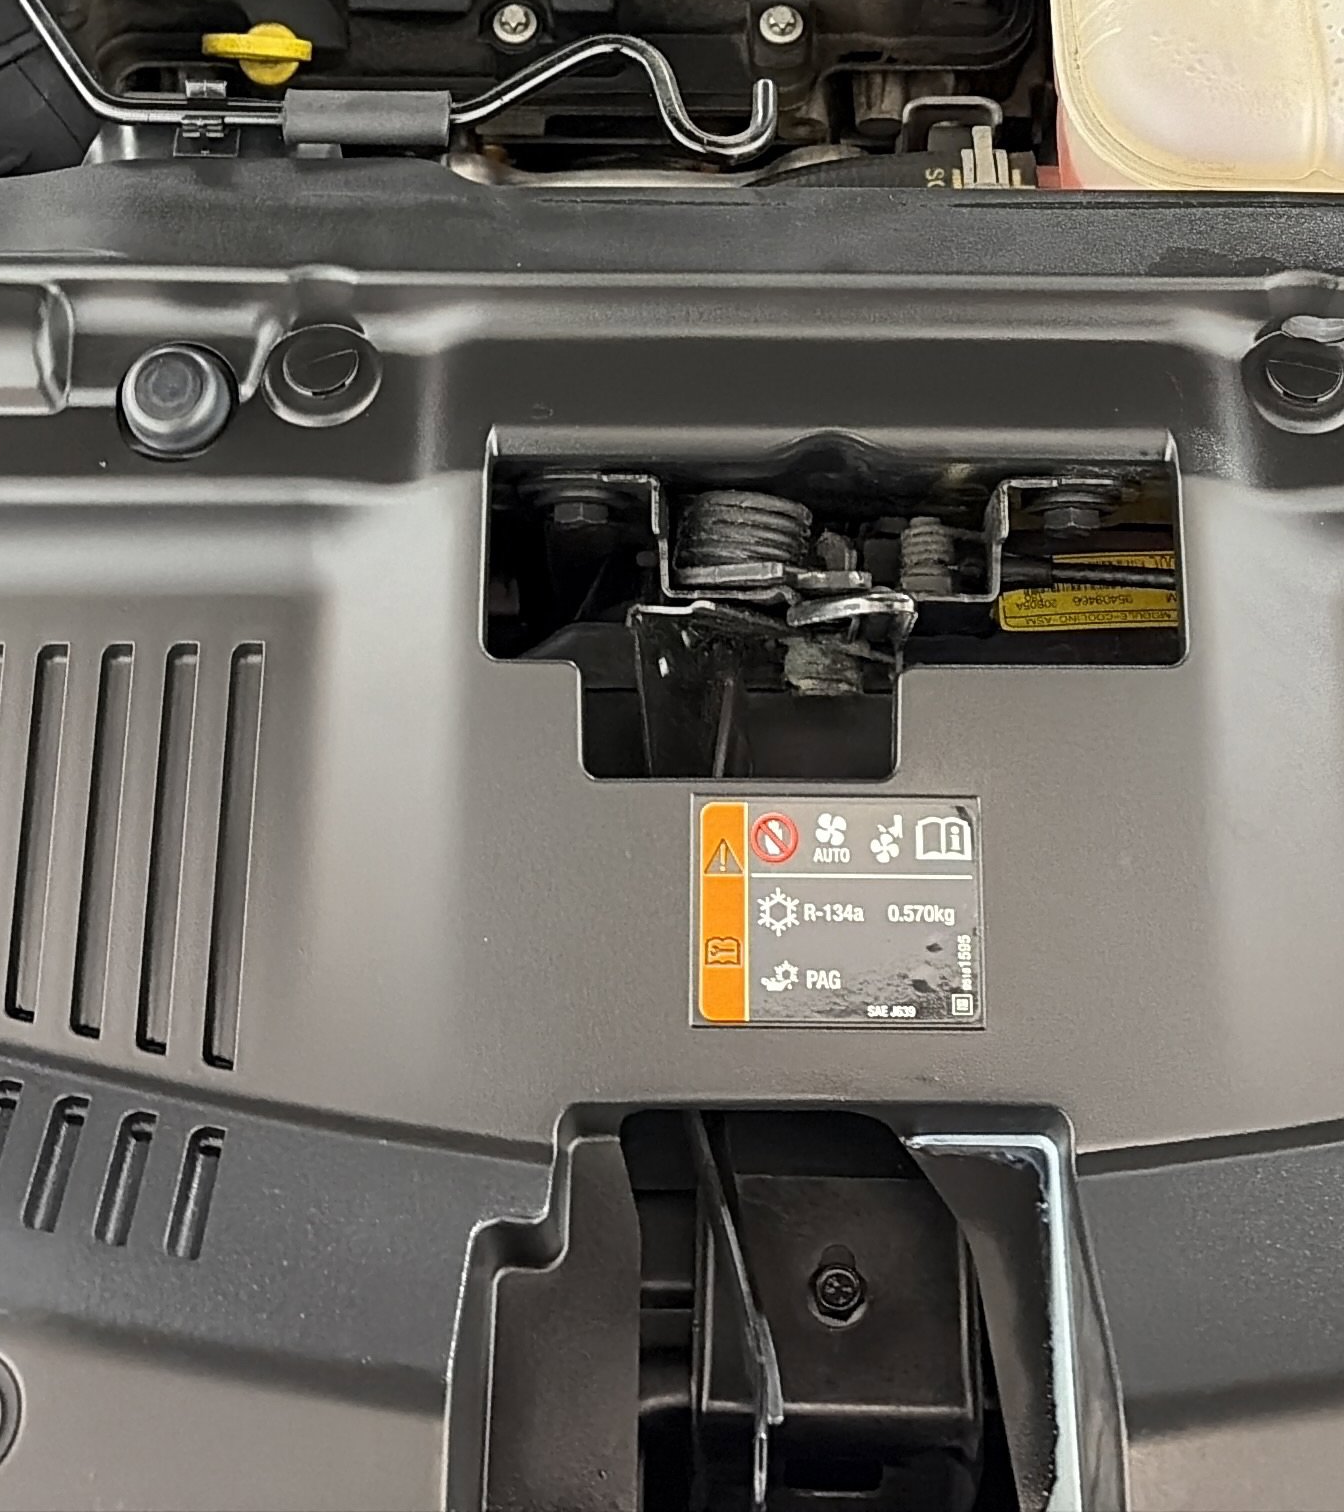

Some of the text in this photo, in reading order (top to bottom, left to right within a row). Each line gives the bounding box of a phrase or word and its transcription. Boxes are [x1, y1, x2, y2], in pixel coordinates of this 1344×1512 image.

[813, 847, 851, 864] AUTO
[804, 904, 956, 926] R-134a 0.570kg
[806, 970, 842, 991] PAG
[867, 1005, 888, 1018] SAE
